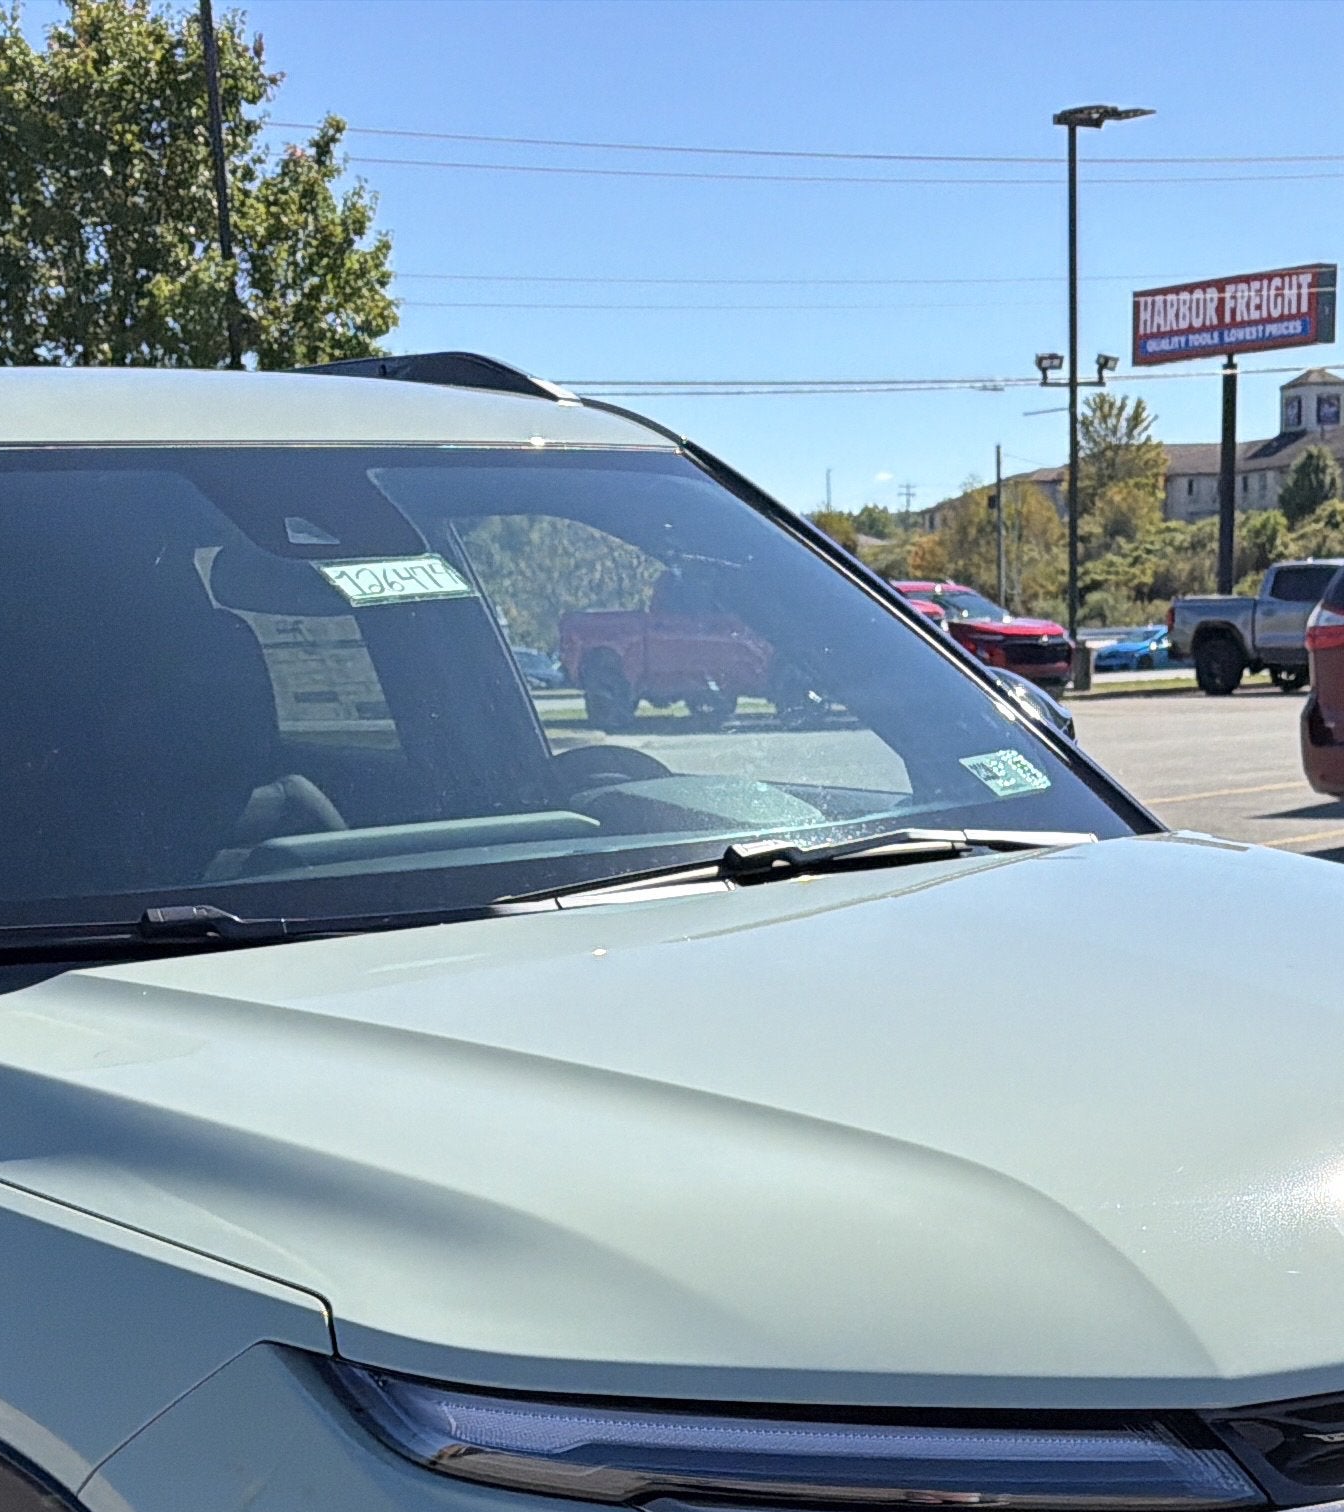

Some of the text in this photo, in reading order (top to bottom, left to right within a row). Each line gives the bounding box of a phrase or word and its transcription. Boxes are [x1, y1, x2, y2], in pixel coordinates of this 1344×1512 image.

[1139, 272, 1313, 336] HARBOR FREIGHT
[1146, 330, 1220, 353] QUALITY TOOLS
[1223, 319, 1302, 343] LOWEST PRICES
